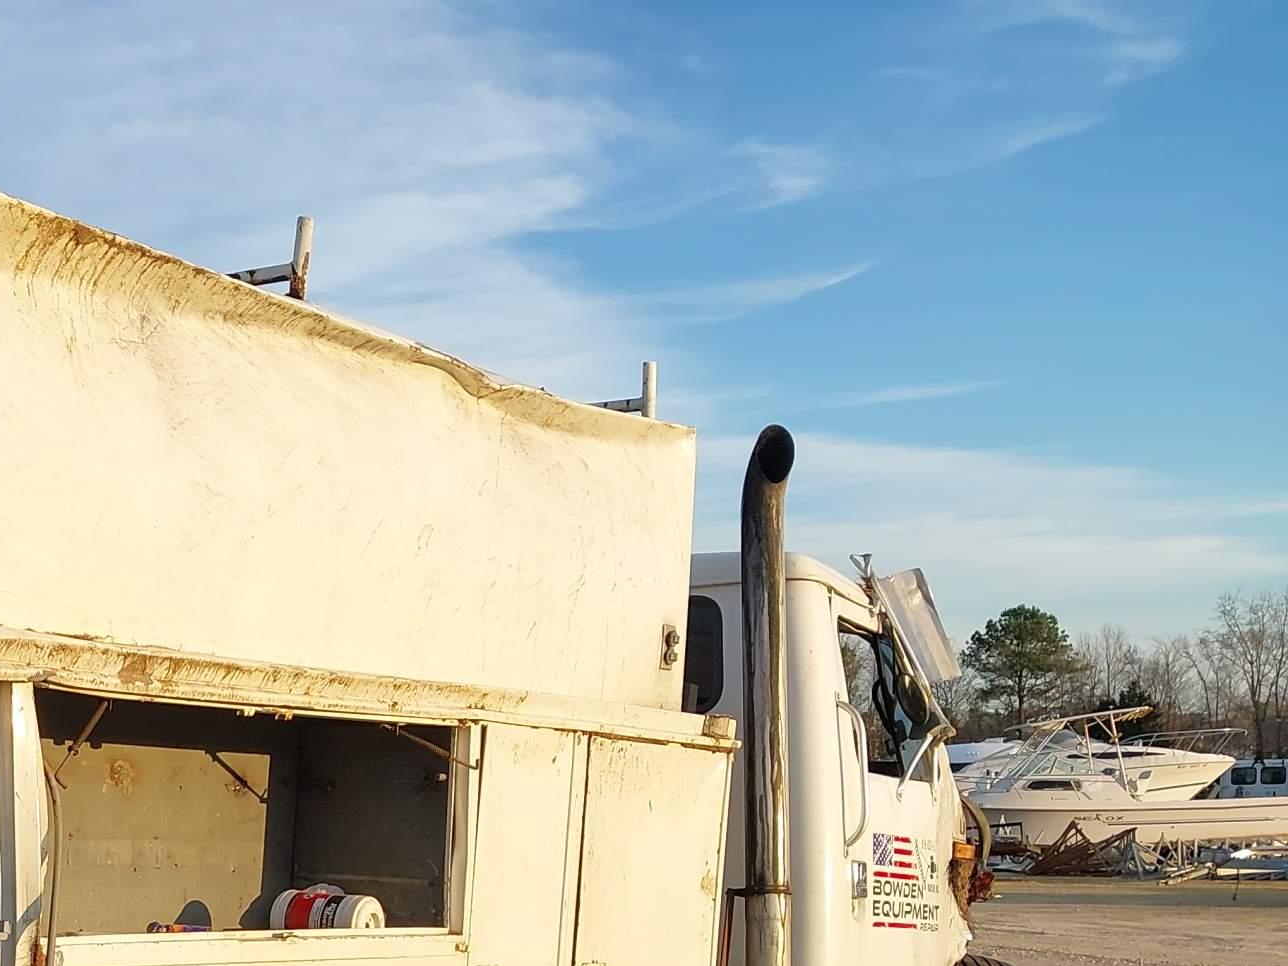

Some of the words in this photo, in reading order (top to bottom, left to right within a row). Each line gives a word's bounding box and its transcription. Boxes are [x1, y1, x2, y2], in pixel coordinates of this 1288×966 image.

[872, 879, 924, 900] BOWDEN
[872, 899, 940, 921] EQUIPMENT
[919, 922, 939, 932] REPAIR
